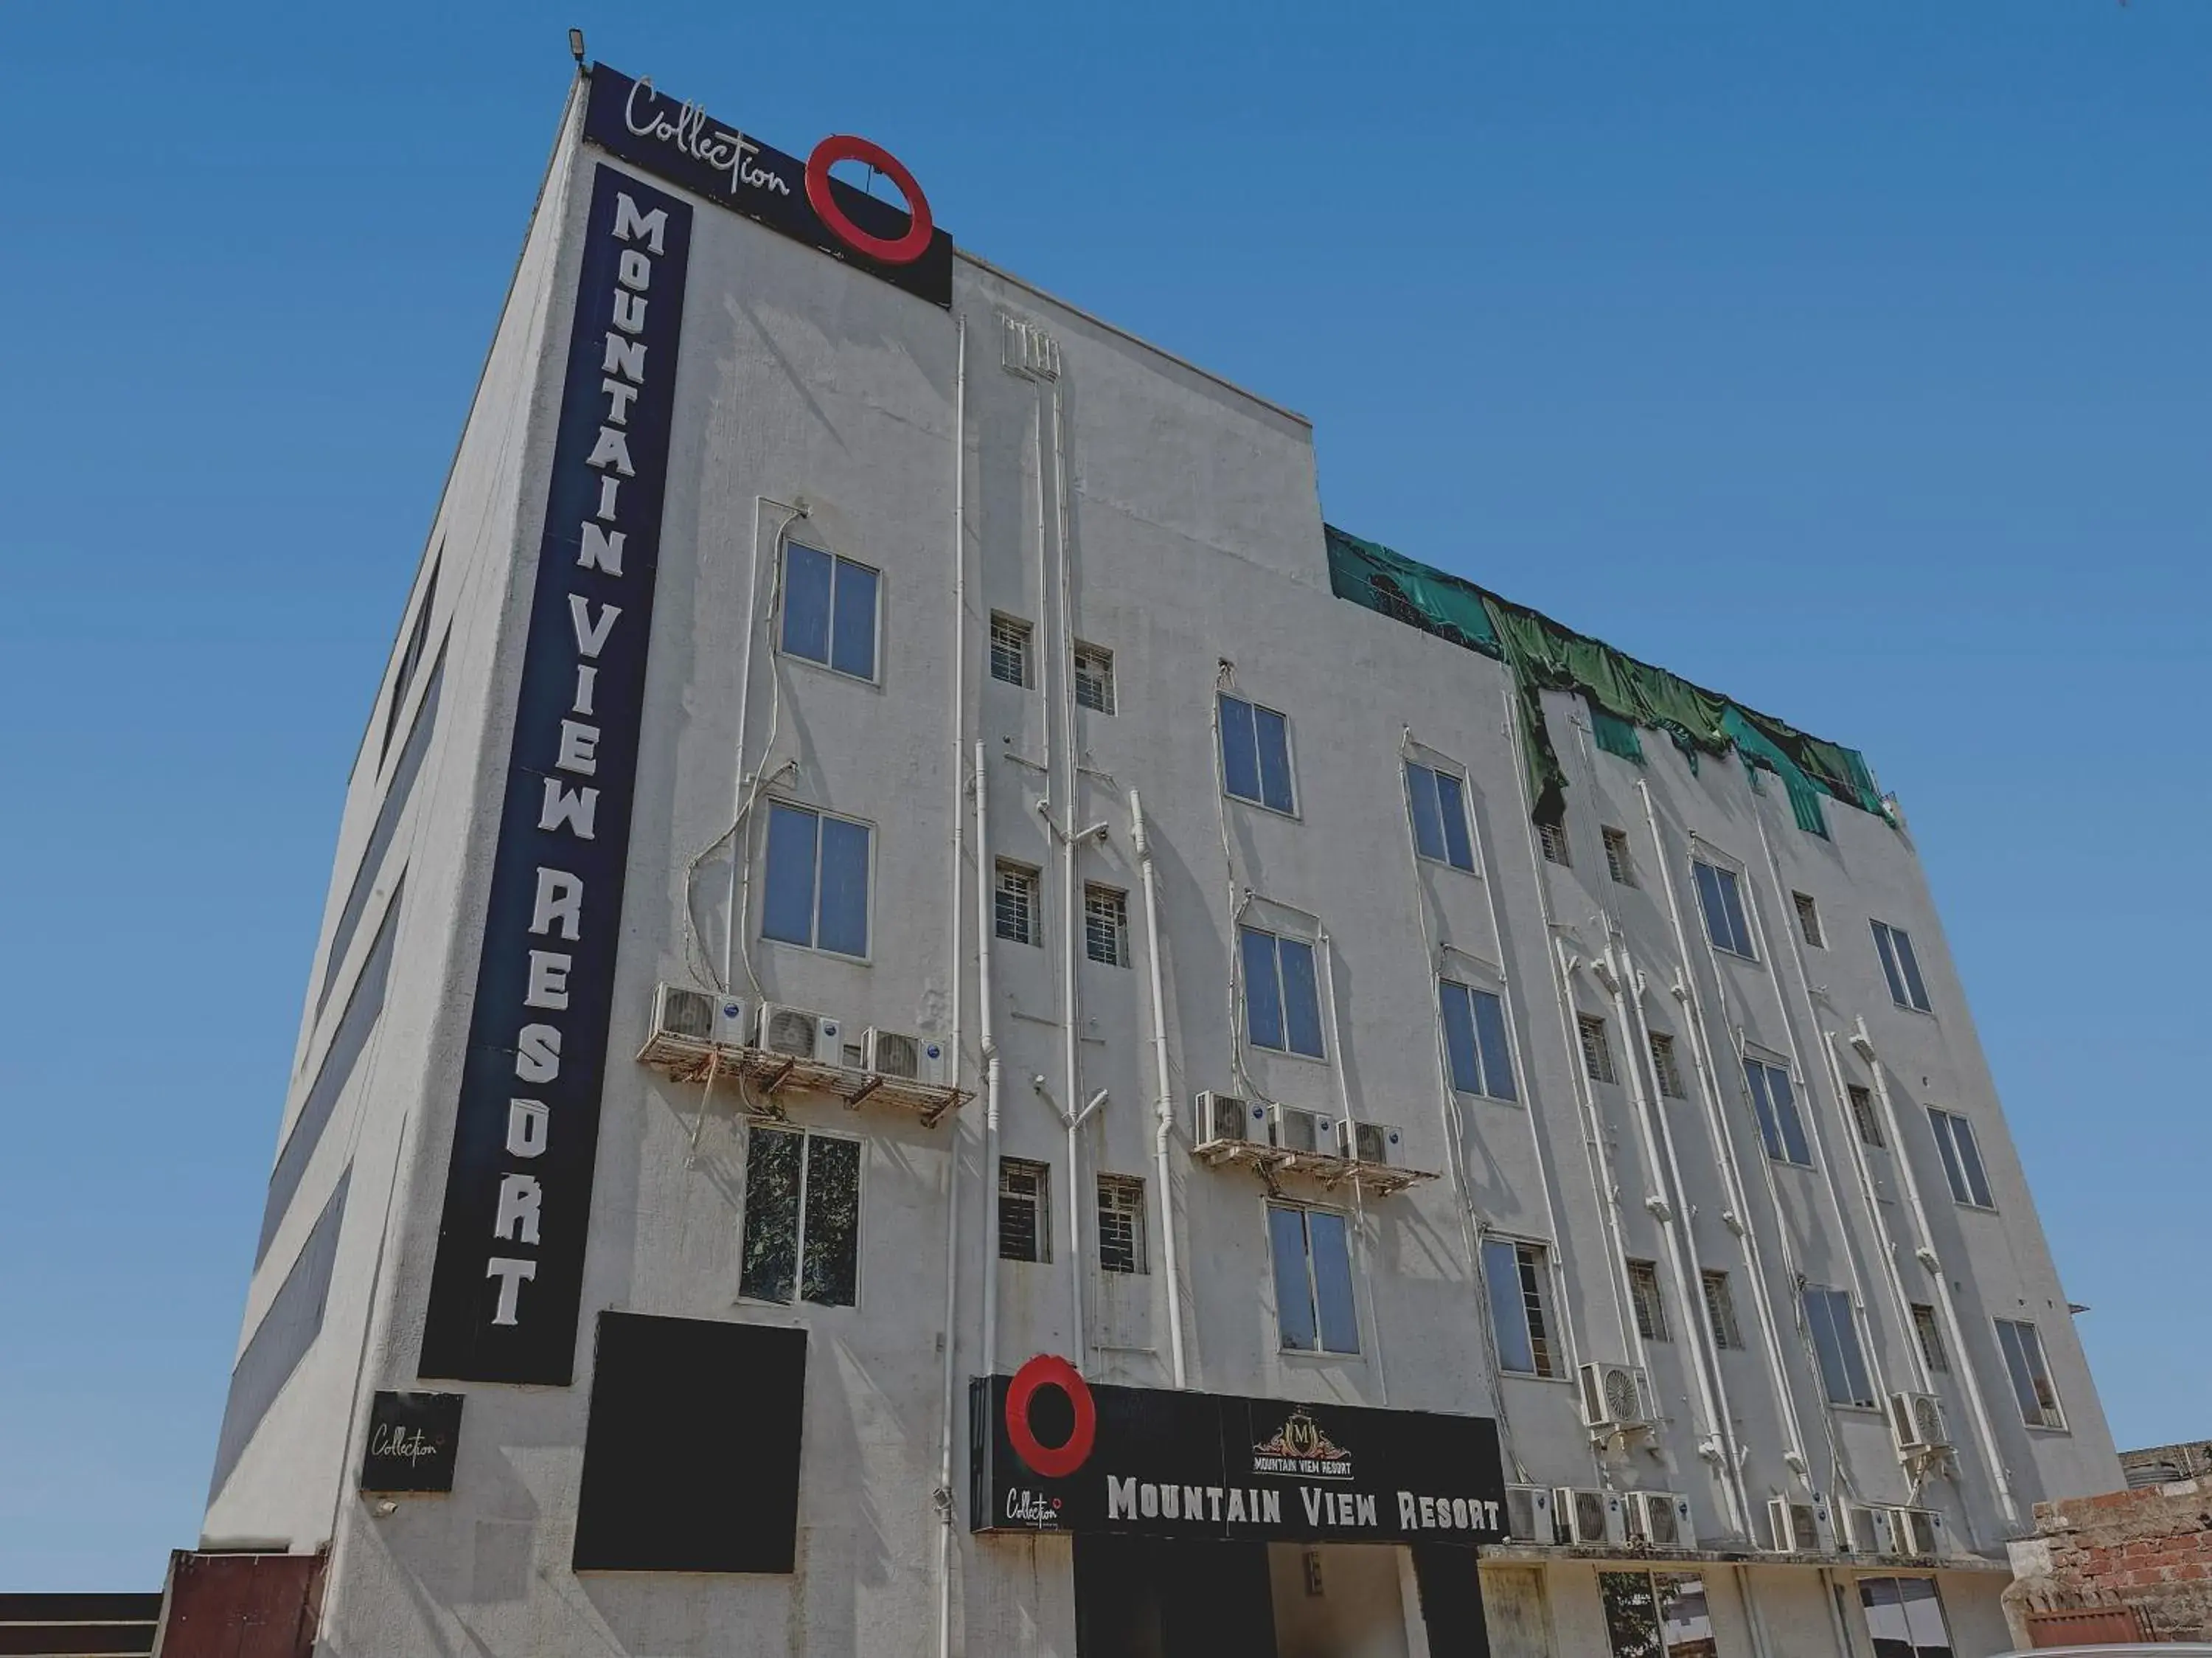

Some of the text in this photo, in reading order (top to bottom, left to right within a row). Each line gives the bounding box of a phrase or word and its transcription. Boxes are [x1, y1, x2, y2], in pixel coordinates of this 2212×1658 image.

[625, 74, 790, 195] Collection
[486, 191, 669, 1326] MOUNTAIN VIEW RESORT
[371, 1422, 437, 1469] Collection
[1294, 1423, 1310, 1444] M
[1254, 1457, 1352, 1475] MOUNTAIN VIEW RESORT
[1006, 1488, 1057, 1530] Collection
[1107, 1475, 1500, 1531] MOUNTAIN VIEW RESORT
